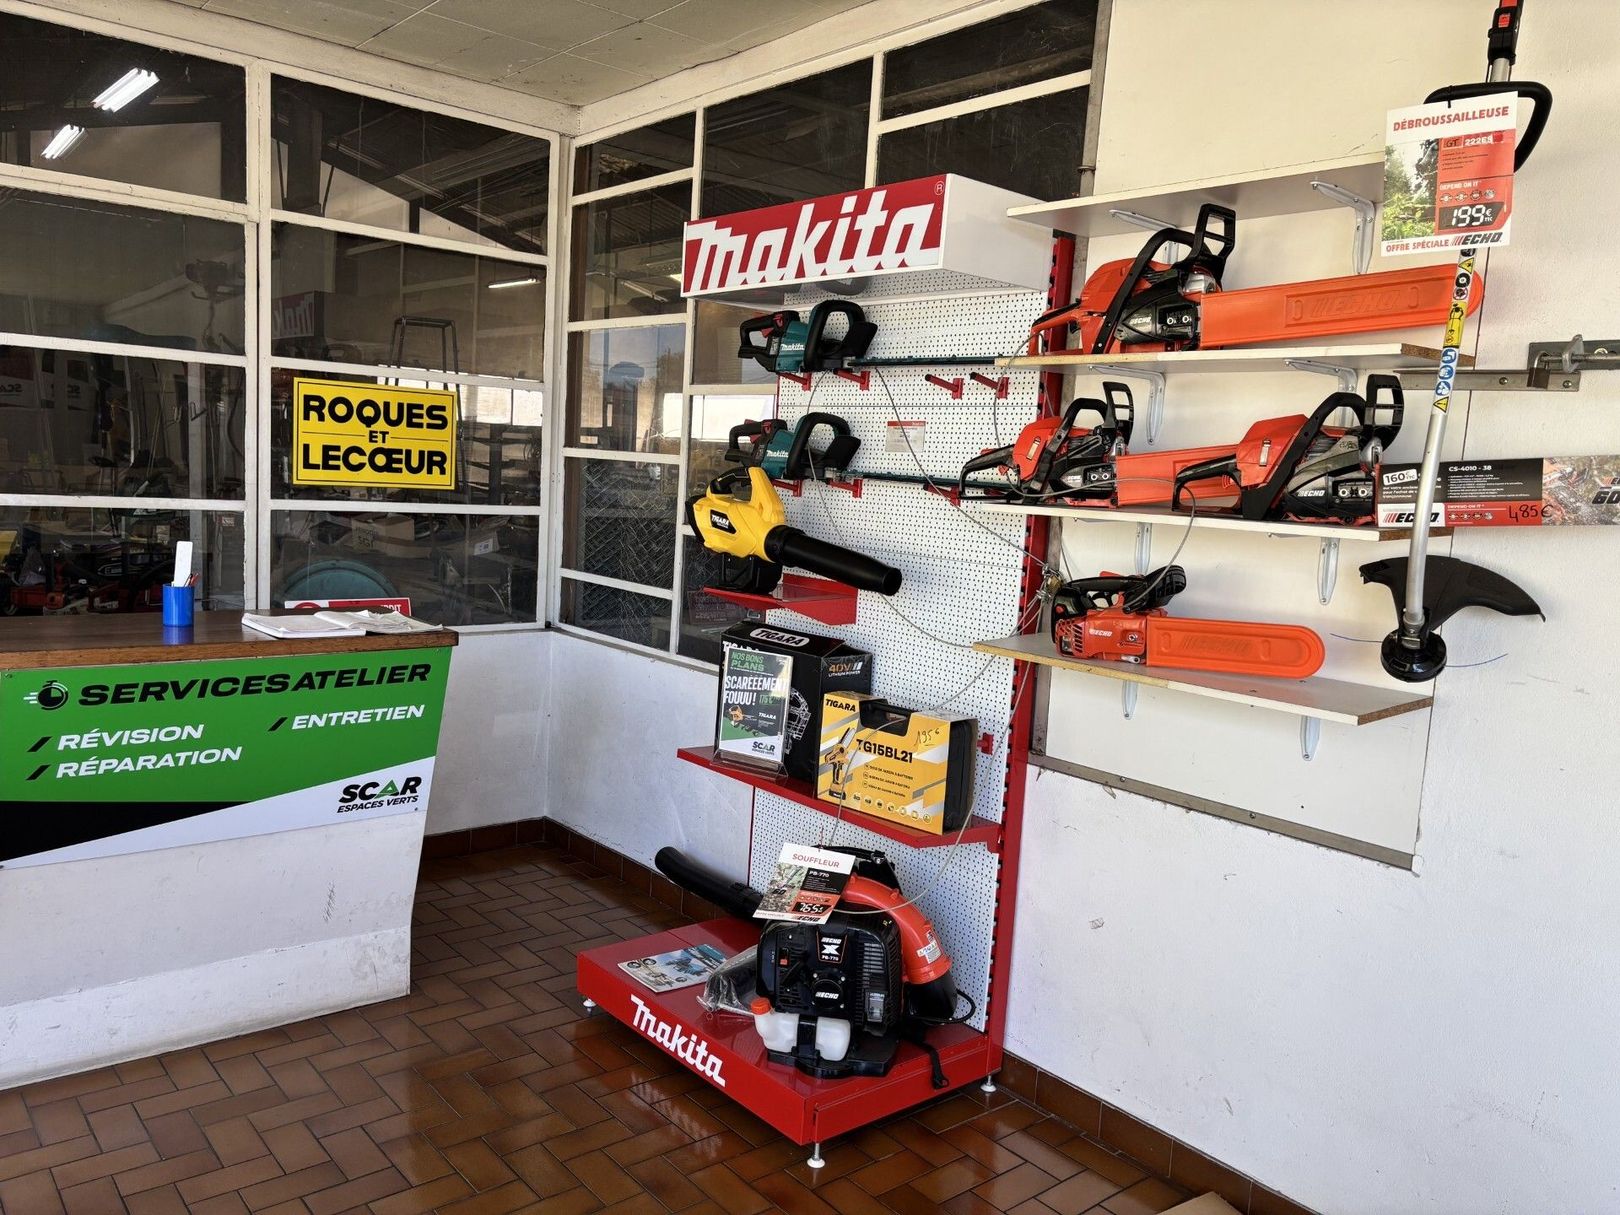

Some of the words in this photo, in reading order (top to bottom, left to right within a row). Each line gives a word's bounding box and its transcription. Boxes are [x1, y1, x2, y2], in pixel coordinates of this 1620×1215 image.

[1393, 106, 1509, 132] DÉBROUSSAILLEUSE
[1386, 242, 1410, 252] OFFRE
[1412, 239, 1449, 250] SPÉCIALE
[1462, 232, 1503, 245] ECHO
[303, 394, 448, 430] ROQUES
[368, 430, 390, 444] ET
[302, 444, 448, 476] LECŒUR
[1395, 512, 1440, 523] ECO
[756, 630, 804, 645] TIGARA
[731, 660, 765, 671] PLANS
[825, 698, 856, 712] TIGARA
[291, 704, 426, 730] ENTRETIEN
[57, 724, 204, 750] RÉVISION
[752, 741, 776, 752] SCAR
[856, 739, 913, 764] TG15BL21
[55, 746, 243, 780] RÉPARATION
[338, 776, 422, 803] SCAR
[336, 800, 384, 813] ESPACES
[386, 795, 419, 806] VERTS
[792, 854, 840, 868] SOUFFLEUR
